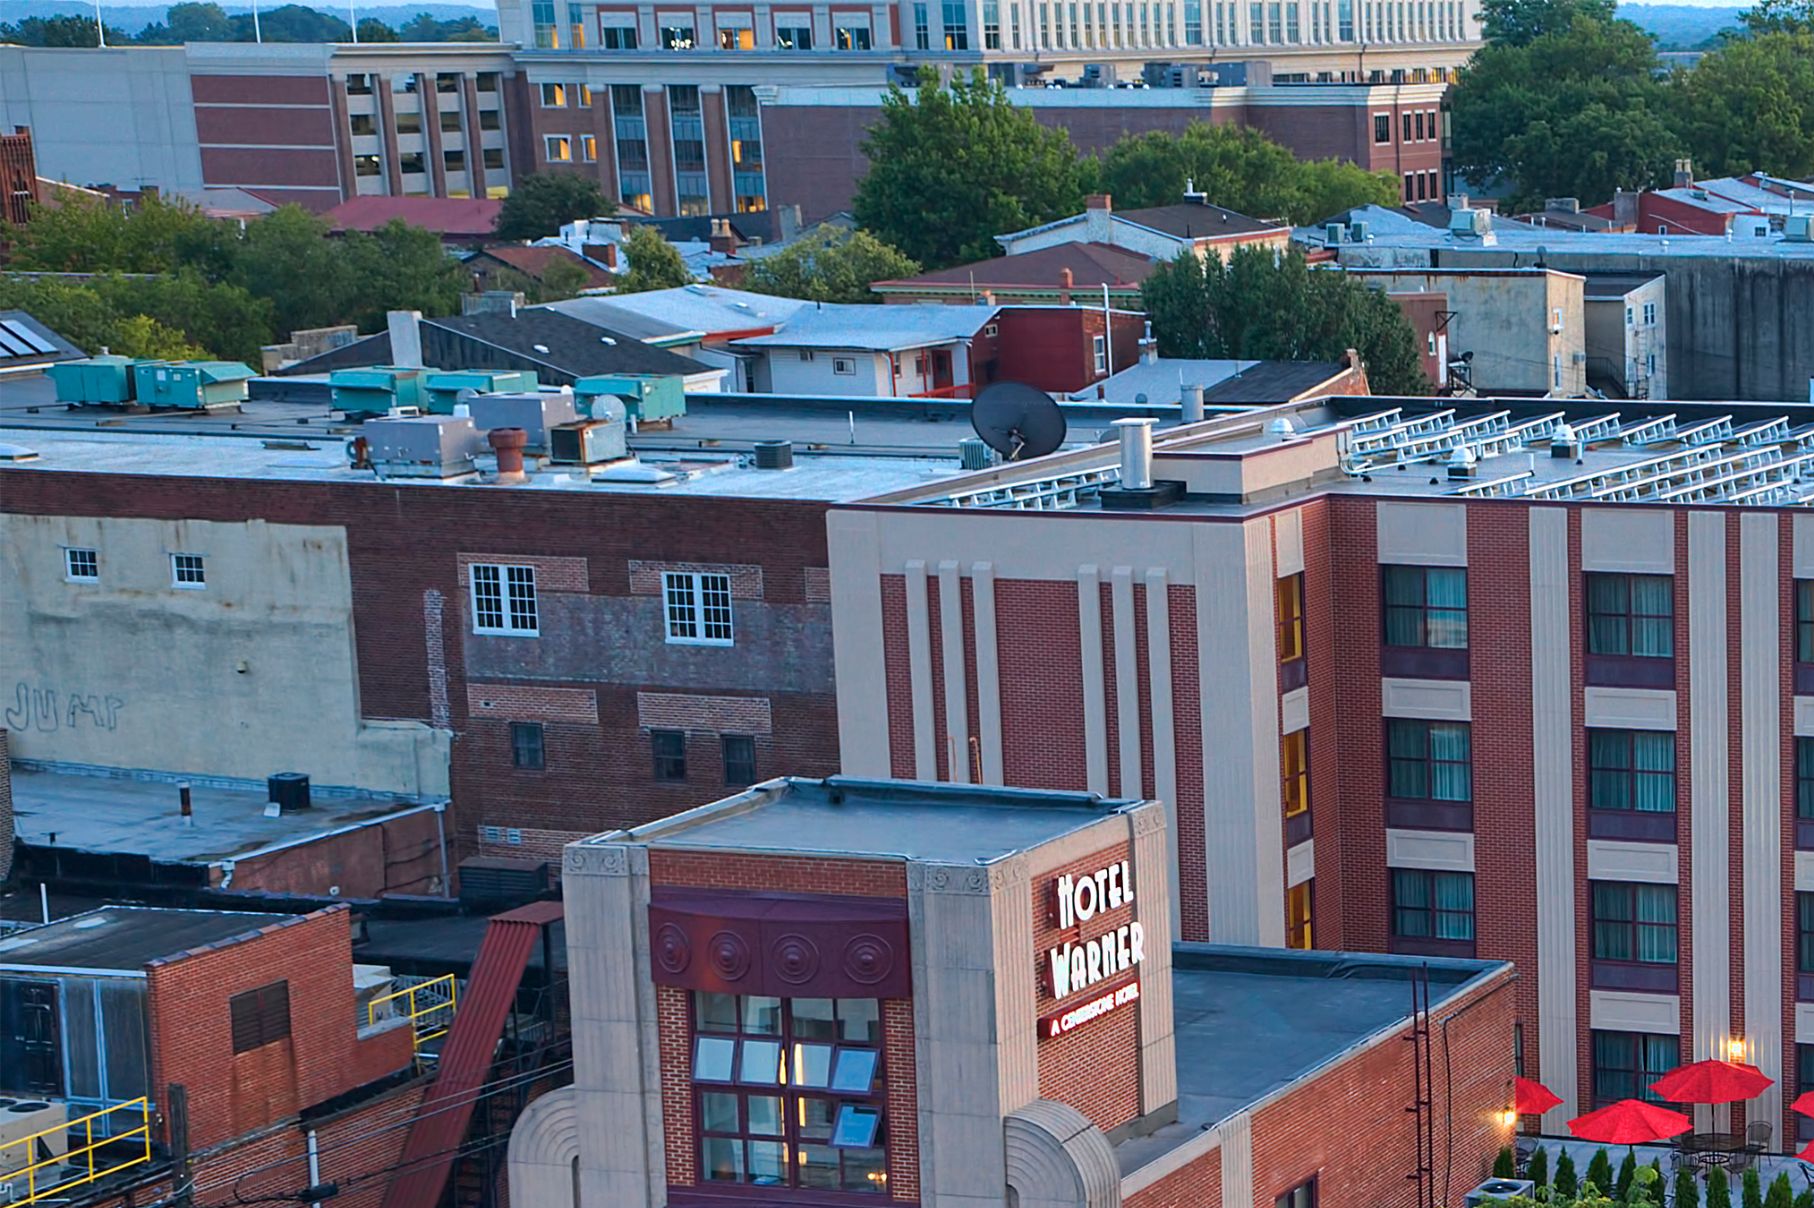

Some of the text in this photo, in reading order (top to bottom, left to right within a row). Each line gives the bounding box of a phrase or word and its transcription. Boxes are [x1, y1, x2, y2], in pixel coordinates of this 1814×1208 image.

[1057, 860, 1134, 930] HOTEL
[1050, 921, 1145, 1000] WARNER
[1050, 1018, 1060, 1036] A
[1115, 983, 1139, 1007] HOTEL
